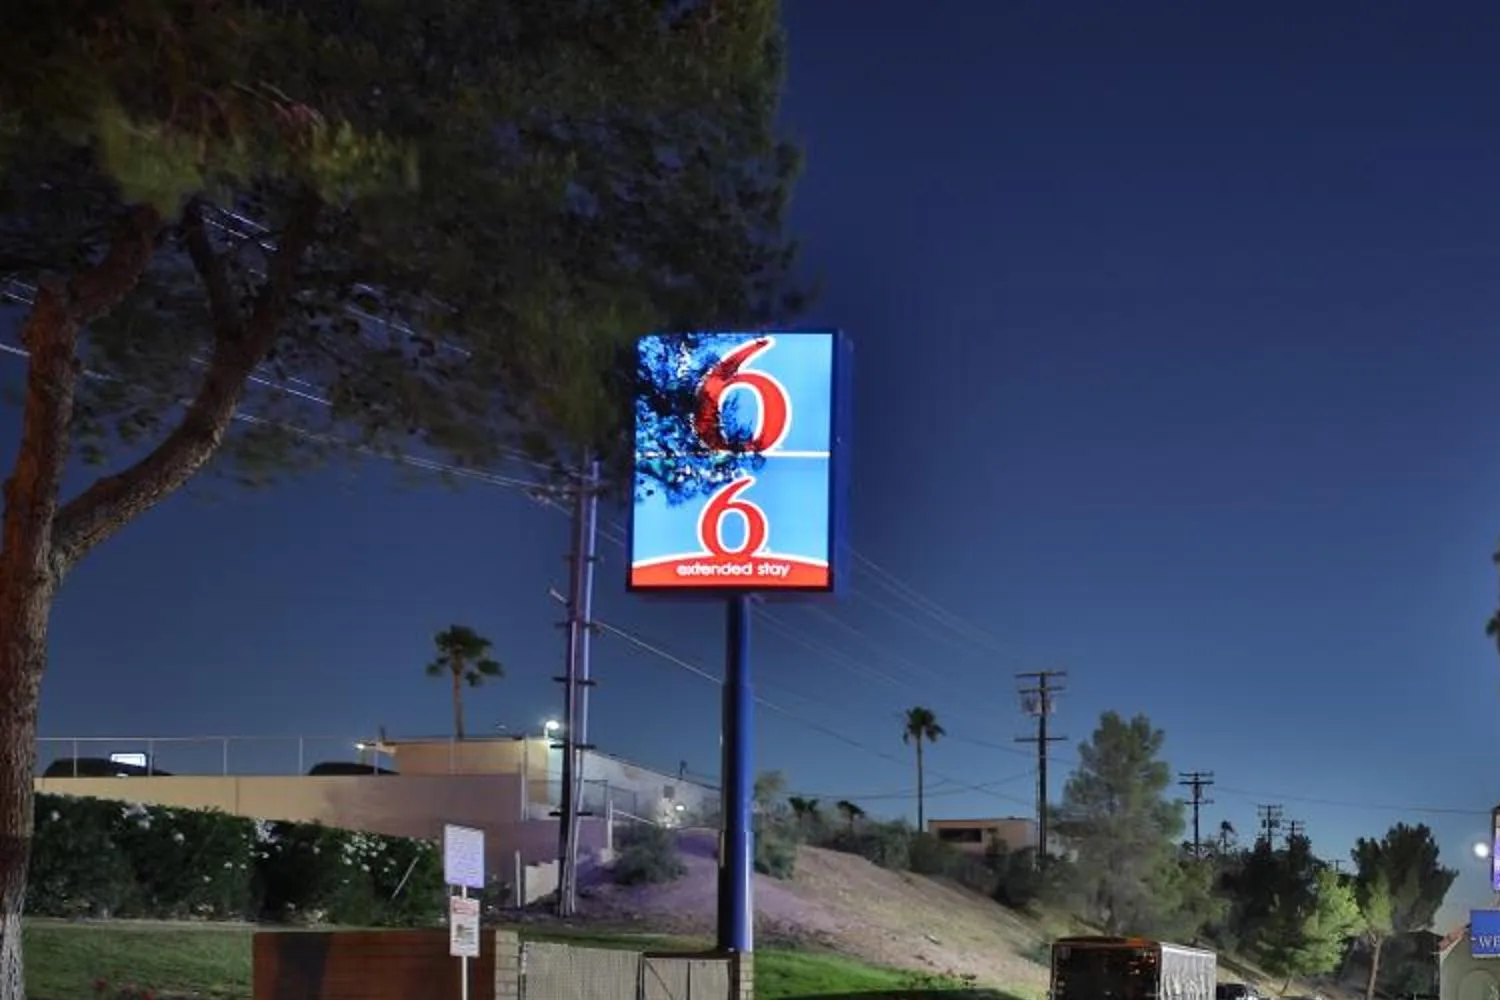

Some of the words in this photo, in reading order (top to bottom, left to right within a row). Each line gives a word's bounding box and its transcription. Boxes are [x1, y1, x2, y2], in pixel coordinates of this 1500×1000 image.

[695, 337, 791, 453] 6
[698, 476, 768, 557] 6
[676, 561, 753, 577] extended
[757, 561, 791, 578] stay
